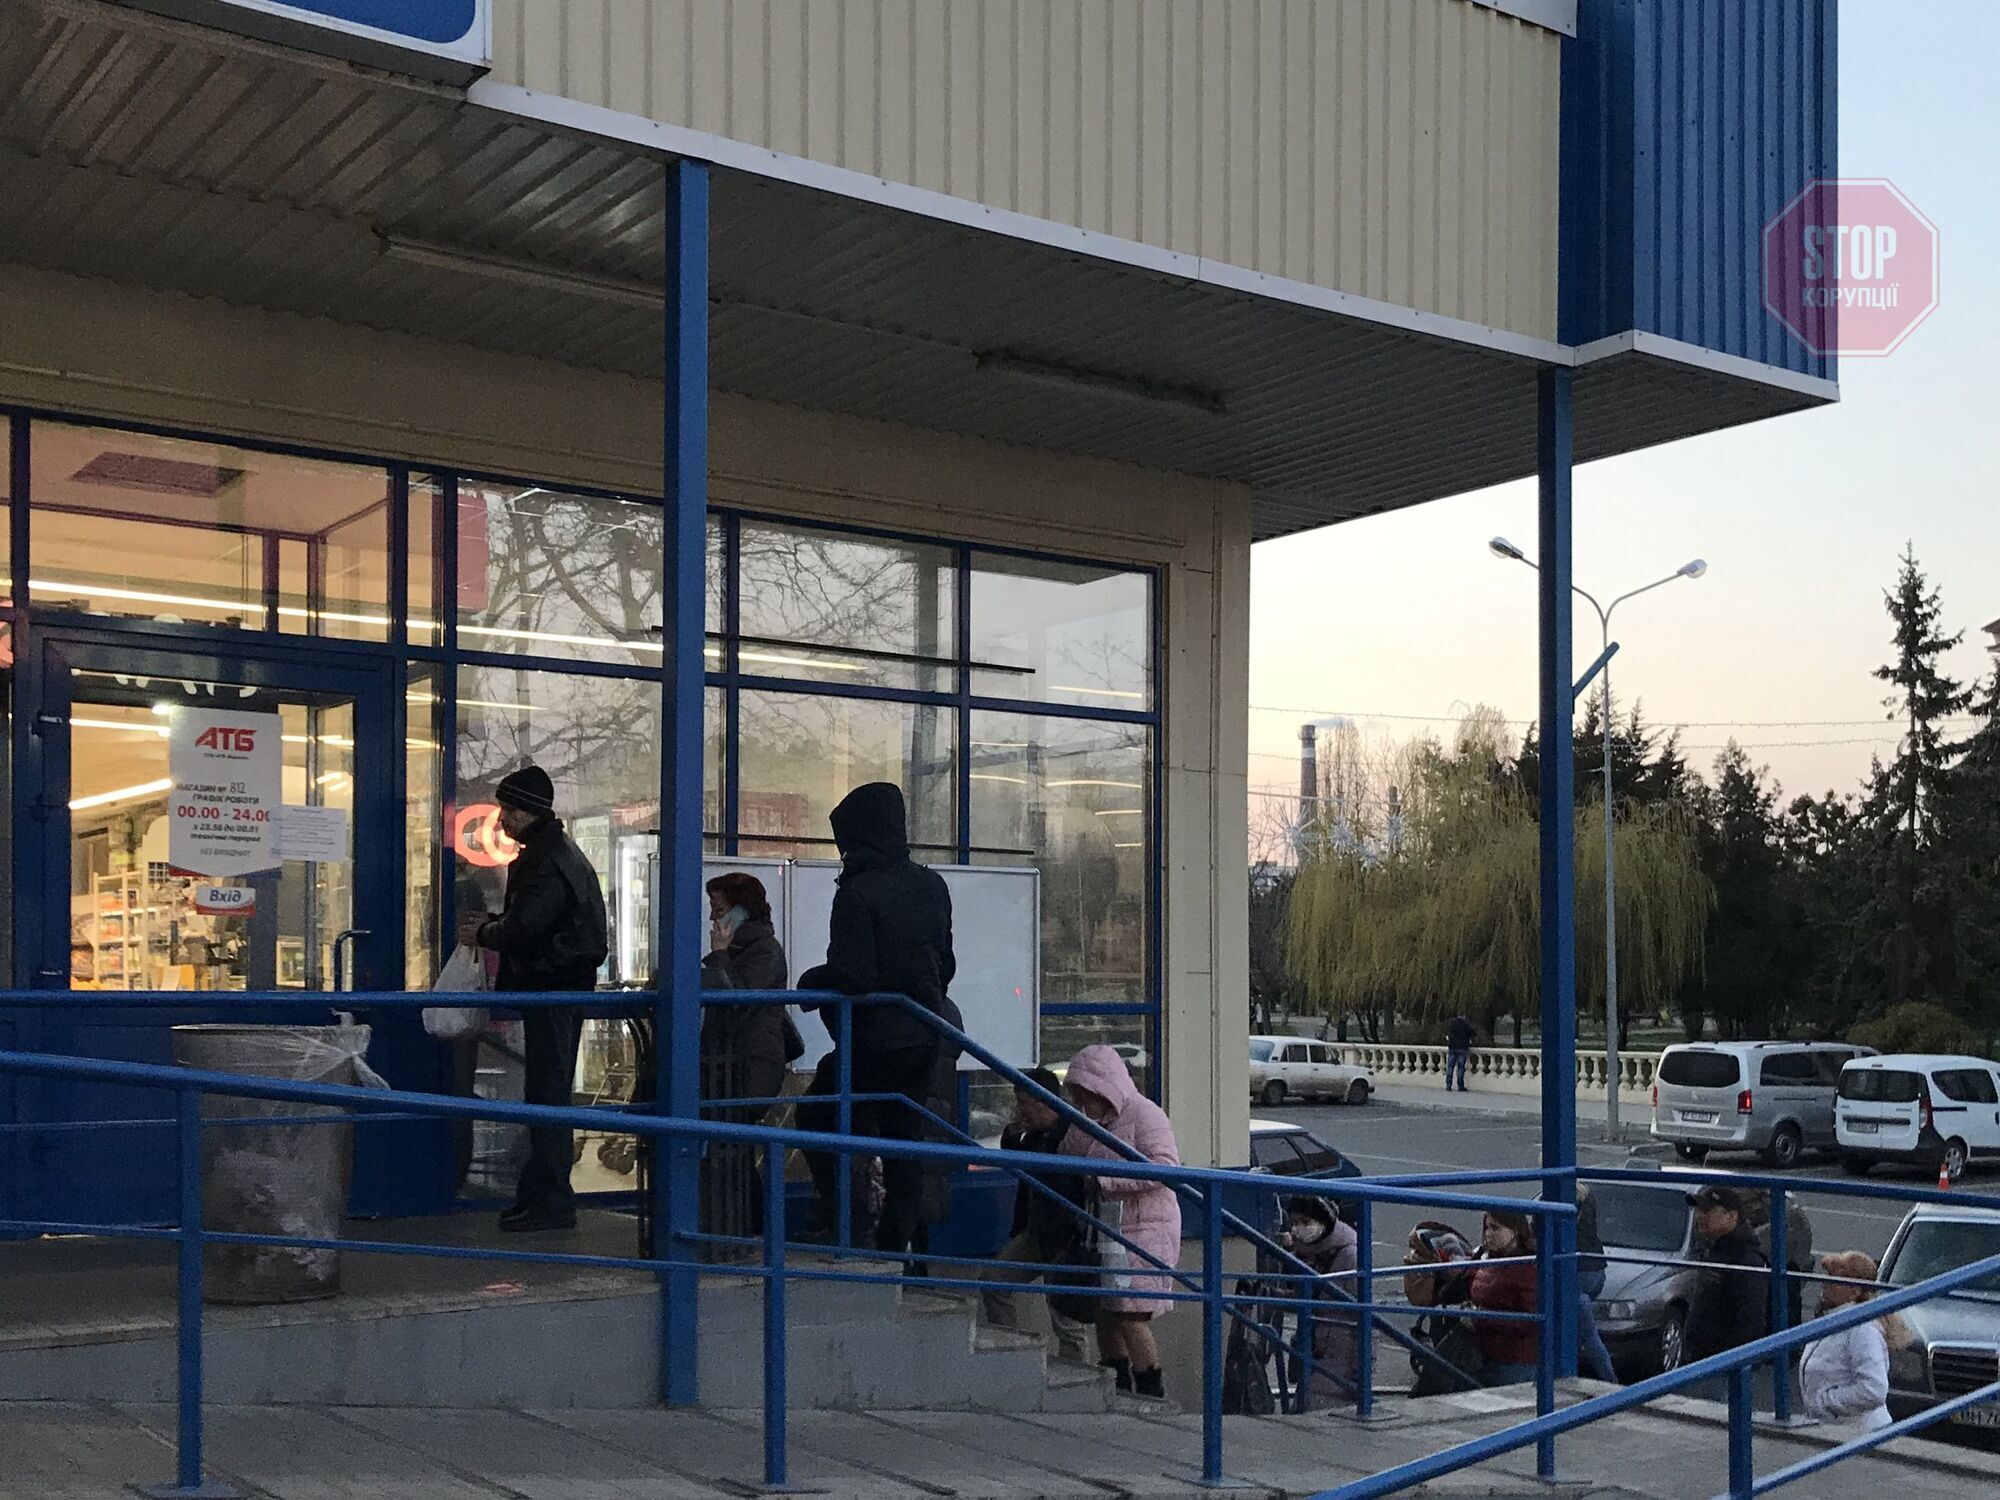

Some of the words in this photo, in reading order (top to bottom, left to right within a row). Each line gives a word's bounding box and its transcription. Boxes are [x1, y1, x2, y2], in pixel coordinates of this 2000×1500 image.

[195, 726, 258, 752] АТБ
[229, 781, 246, 794] 812
[177, 805, 220, 819] 00.00
[209, 889, 242, 903] Вхід
